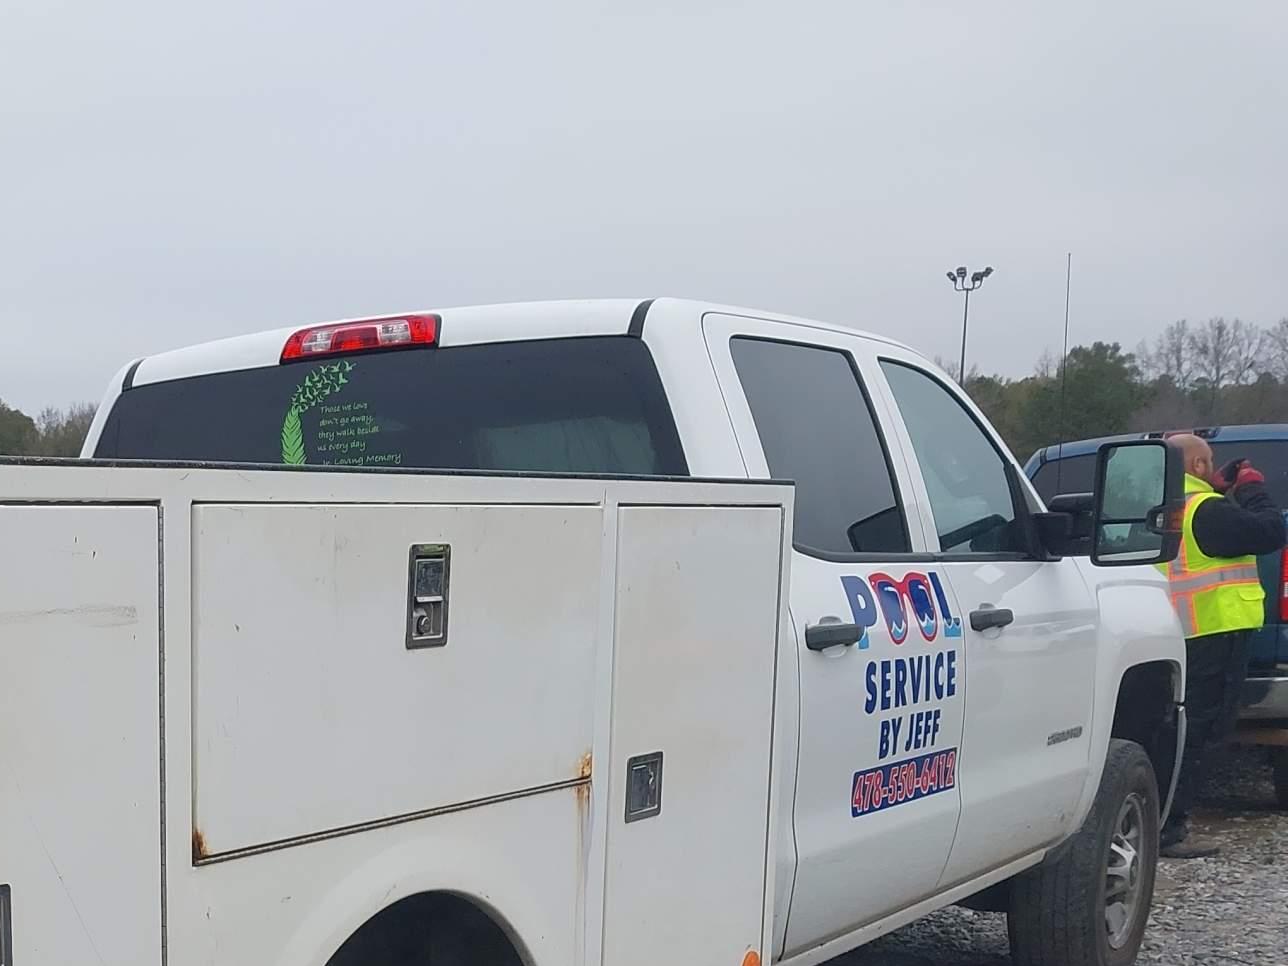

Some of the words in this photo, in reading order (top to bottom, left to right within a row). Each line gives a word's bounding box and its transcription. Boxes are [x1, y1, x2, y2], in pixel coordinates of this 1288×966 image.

[318, 431, 335, 441] they
[336, 427, 356, 436] walk
[328, 442, 349, 453] every
[350, 439, 366, 451] day
[334, 456, 364, 466] Loving
[365, 453, 401, 465] Memory
[840, 571, 962, 650] POOL
[864, 650, 957, 715] SERVICE
[878, 716, 903, 761] BY
[904, 709, 941, 752] JEFF
[851, 750, 957, 813] 478-550-6412
